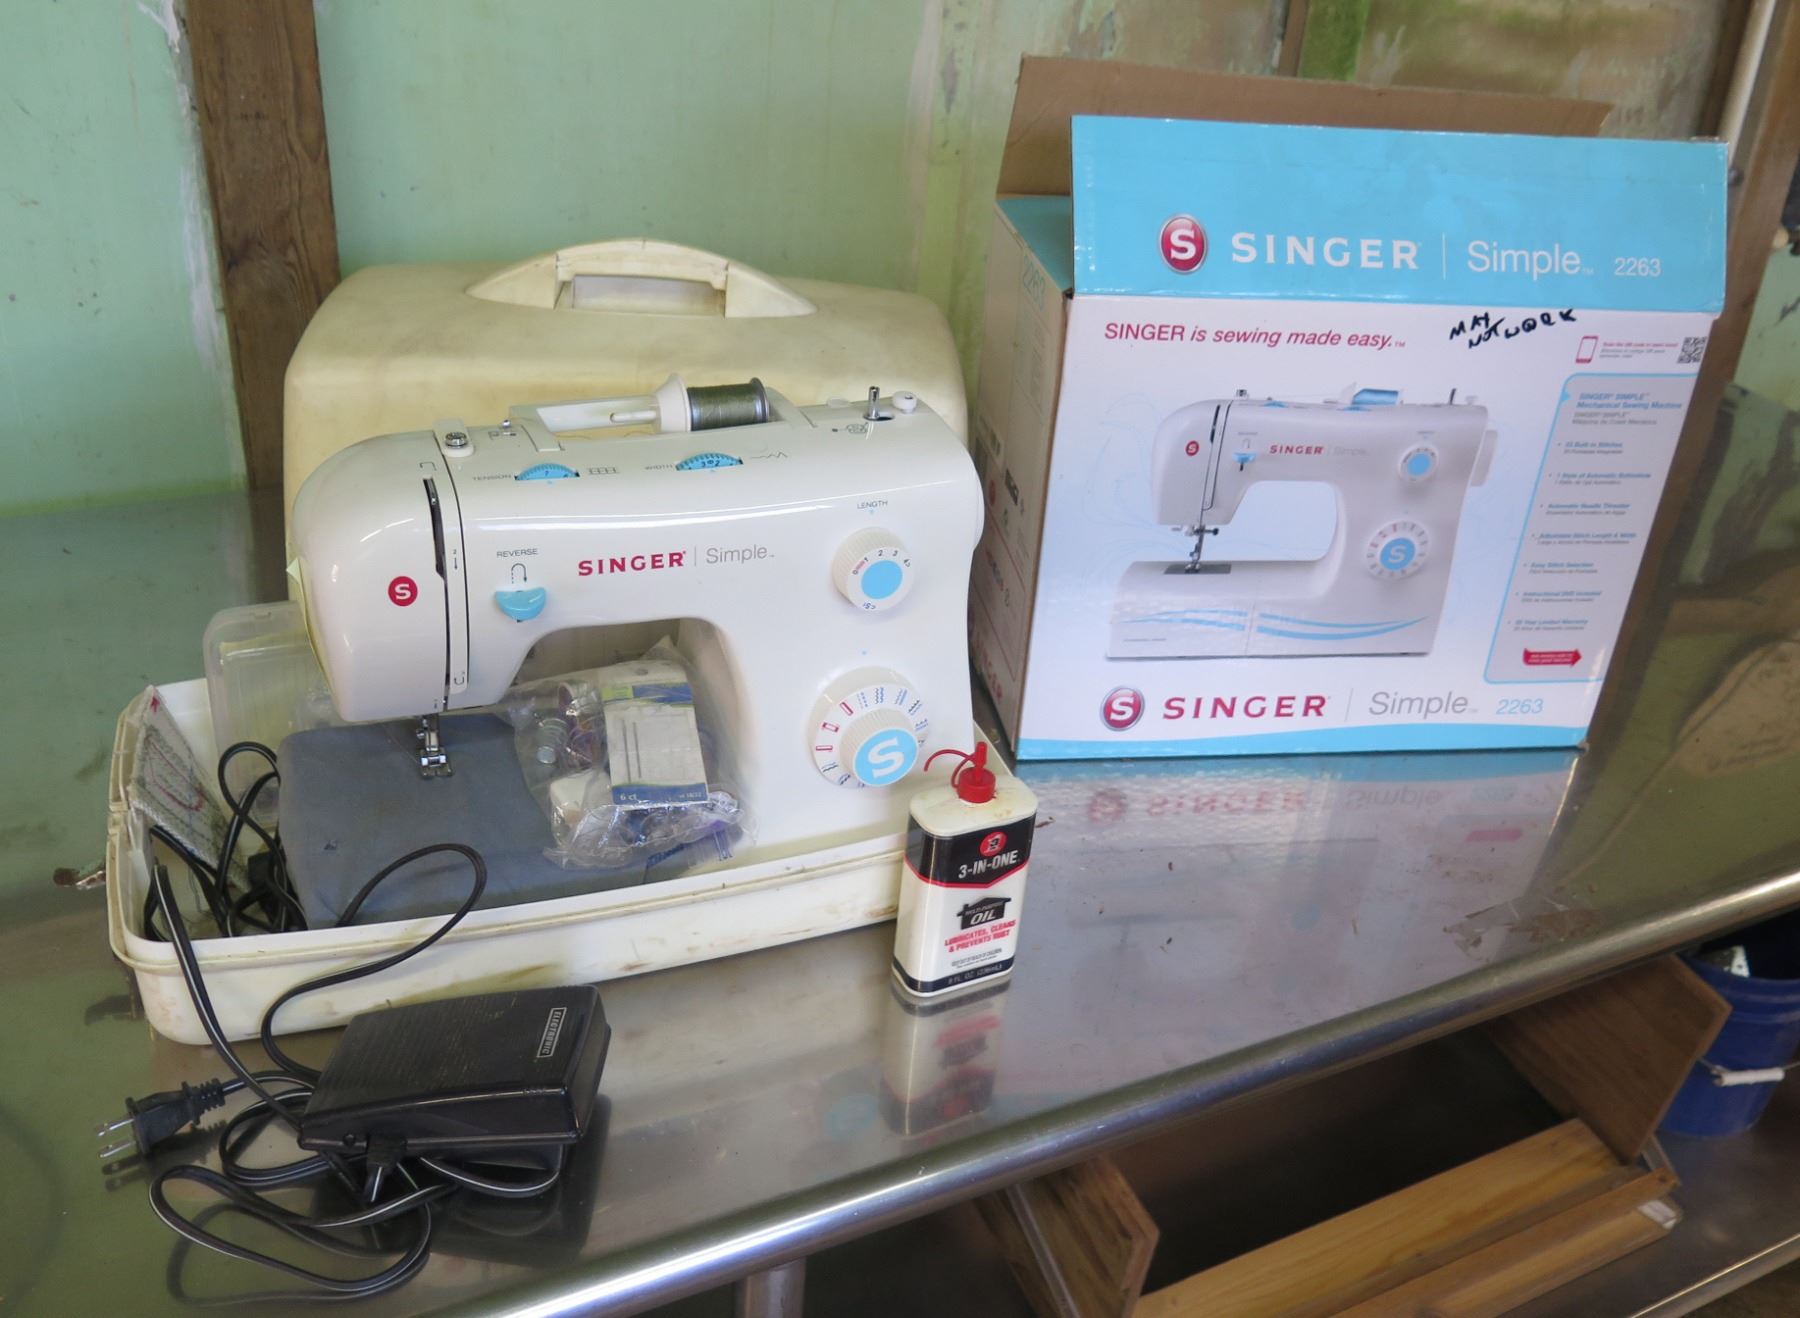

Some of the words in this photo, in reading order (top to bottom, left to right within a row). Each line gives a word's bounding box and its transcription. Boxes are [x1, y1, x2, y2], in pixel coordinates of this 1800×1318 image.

[1231, 231, 1419, 271] SINGER
[1614, 257, 1661, 278] 2263
[1104, 322, 1186, 342] SINGER
[1190, 326, 1207, 342] is
[1212, 327, 1282, 348] sewing
[1286, 329, 1342, 346] made
[1449, 311, 1490, 340] MAY
[1468, 317, 1505, 349] NOT
[1504, 308, 1577, 339] WORK
[1269, 445, 1324, 455] SINGER
[857, 500, 889, 510] LENGTH
[496, 548, 539, 558] REVERSE
[578, 551, 687, 576] SINGER
[1162, 695, 1328, 720] SINGER
[1496, 698, 1544, 715] 2263
[958, 850, 1019, 879] 3-IN-ONE
[969, 909, 996, 925] OIL
[541, 1011, 562, 1054] ELECTRONIC
